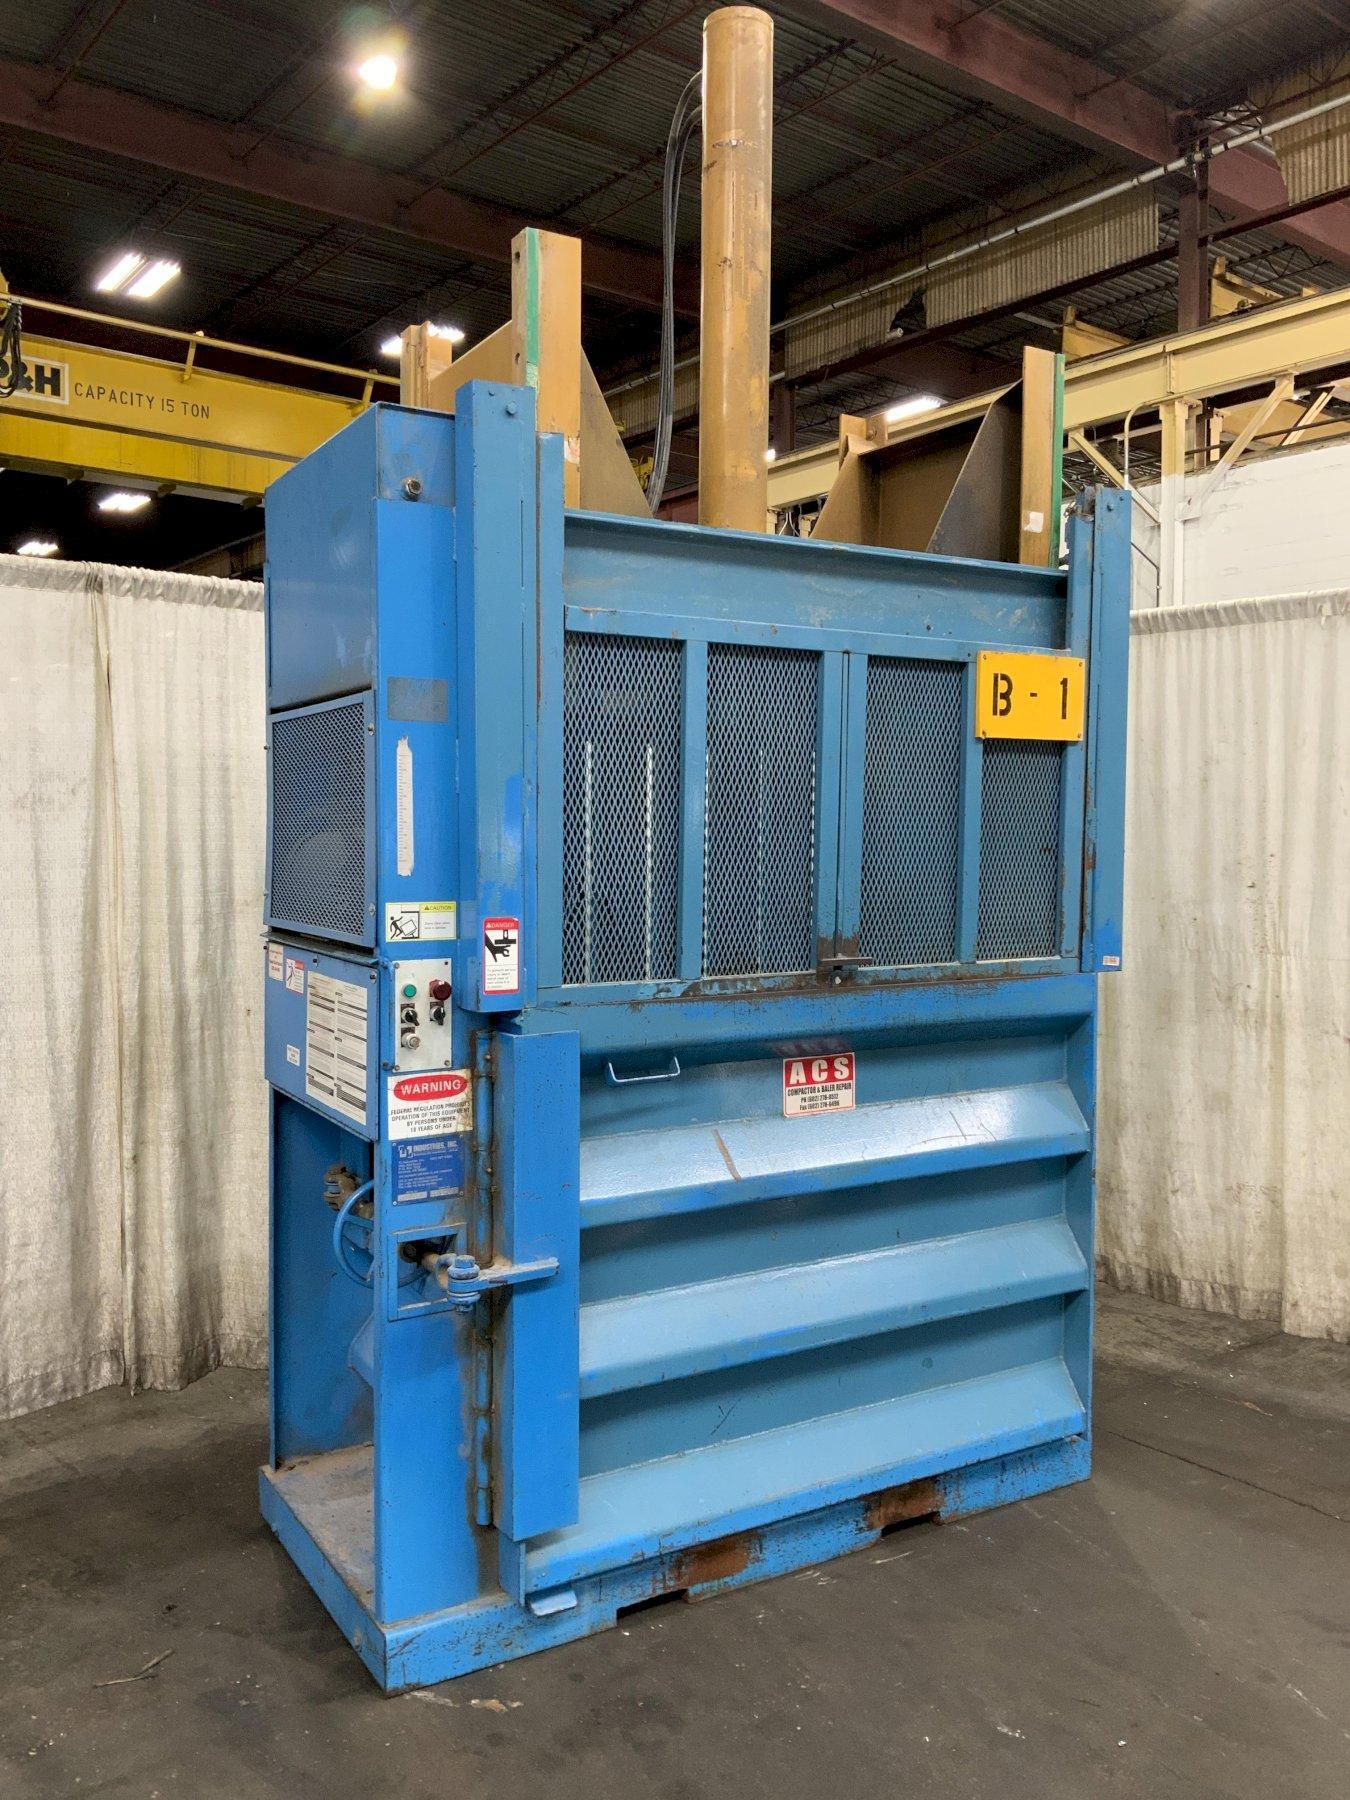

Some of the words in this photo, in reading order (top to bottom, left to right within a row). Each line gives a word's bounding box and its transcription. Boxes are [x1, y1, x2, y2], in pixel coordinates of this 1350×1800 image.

[75, 383, 154, 410] CAPACITY
[162, 398, 174, 412] 15
[181, 402, 209, 419] TON
[993, 673, 1013, 716] B
[1060, 678, 1068, 719] 1
[401, 1079, 461, 1095] WARNING
[788, 1086, 816, 1096] COMPACTOR
[822, 1084, 835, 1092] BALER
[836, 1082, 851, 1090] REPAIR
[414, 1103, 443, 1112] REGULATION
[442, 1108, 470, 1116] EQUIPMENT
